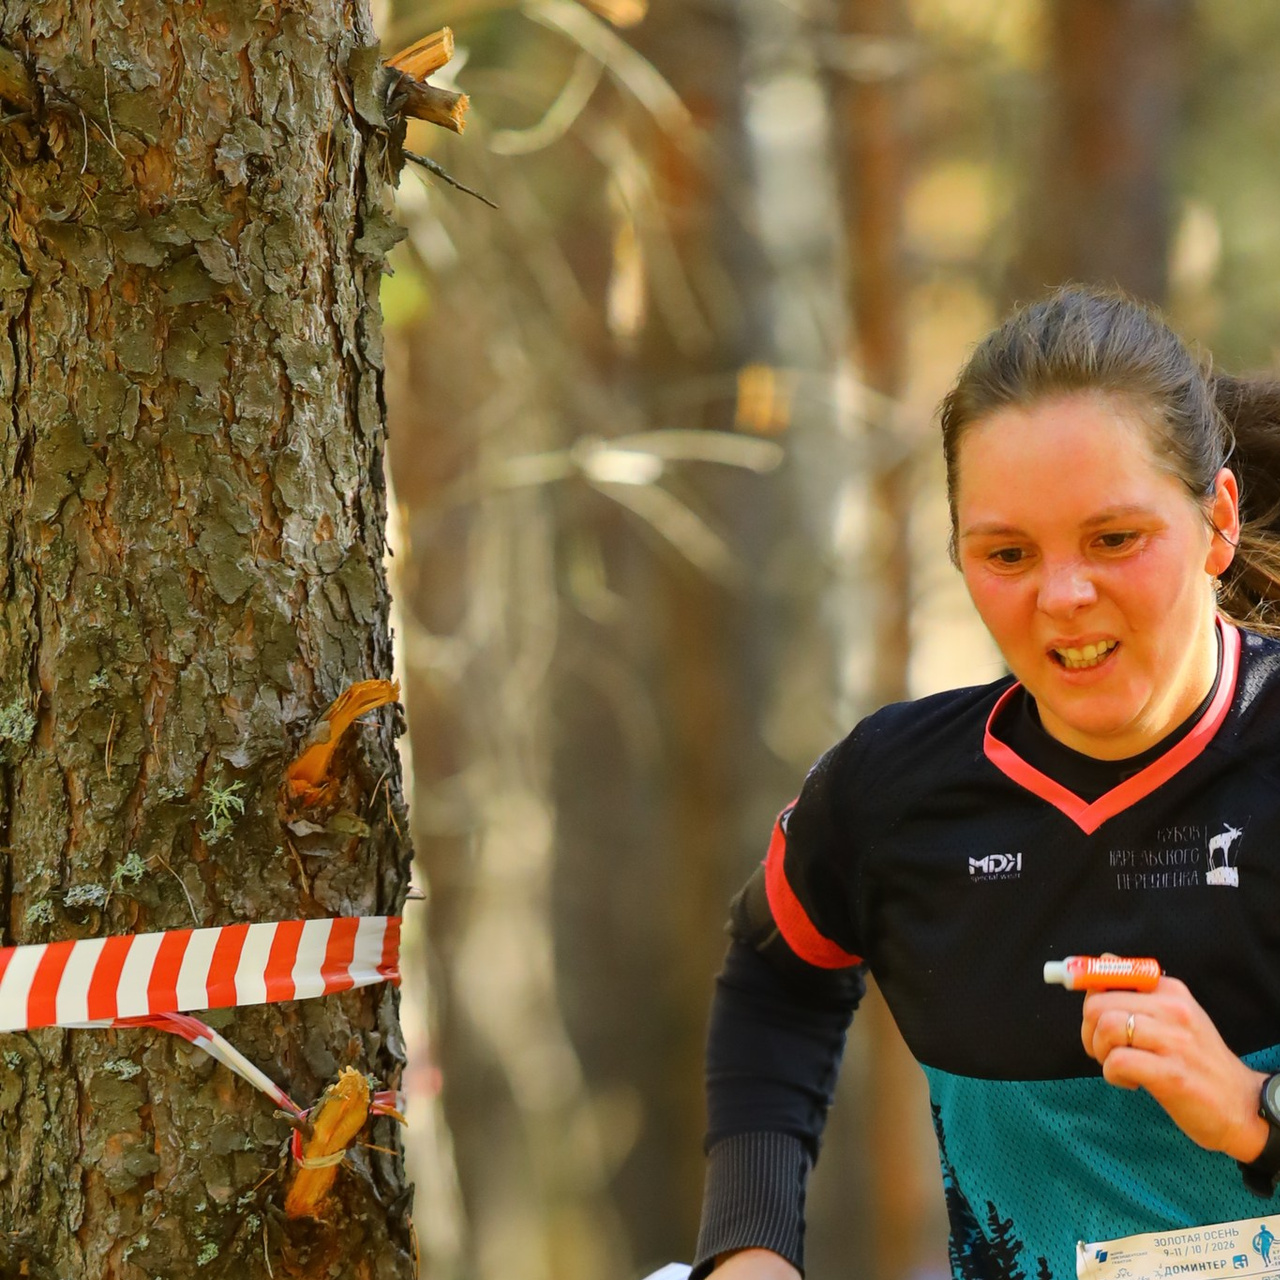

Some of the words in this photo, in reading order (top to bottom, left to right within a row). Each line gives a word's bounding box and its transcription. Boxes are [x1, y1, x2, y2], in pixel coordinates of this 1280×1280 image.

[1153, 1233, 1201, 1247] ЗОЛОТАЯ
[1203, 1228, 1239, 1241] ОСЕНЬ
[1164, 1259, 1227, 1277] ДОМИНТЕР
